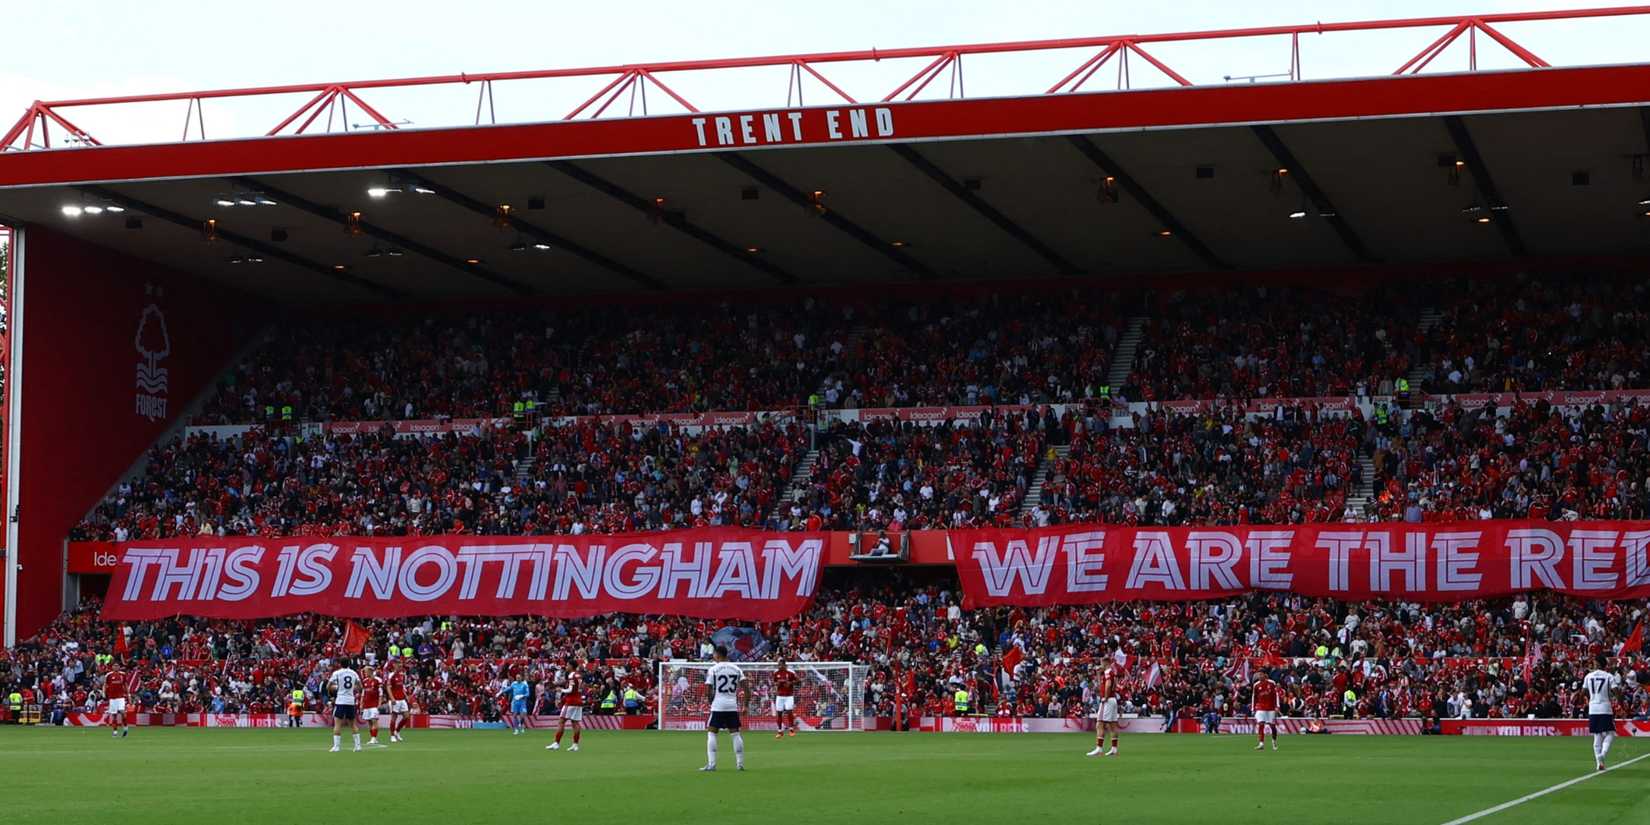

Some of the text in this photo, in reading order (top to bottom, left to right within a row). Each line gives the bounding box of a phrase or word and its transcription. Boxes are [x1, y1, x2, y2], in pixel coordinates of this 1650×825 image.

[692, 108, 894, 146] TRENT END
[910, 409, 943, 421] Ideagen
[122, 539, 823, 602] THIS IS NOTTINGHAM
[971, 531, 1110, 597] WE
[1125, 530, 1295, 591] ARE
[1315, 531, 1484, 592] THE
[343, 675, 353, 689] 8
[718, 674, 738, 693] 23
[1590, 677, 1606, 694] 17
[1496, 725, 1520, 736] YOU
[1523, 725, 1555, 736] REDS
